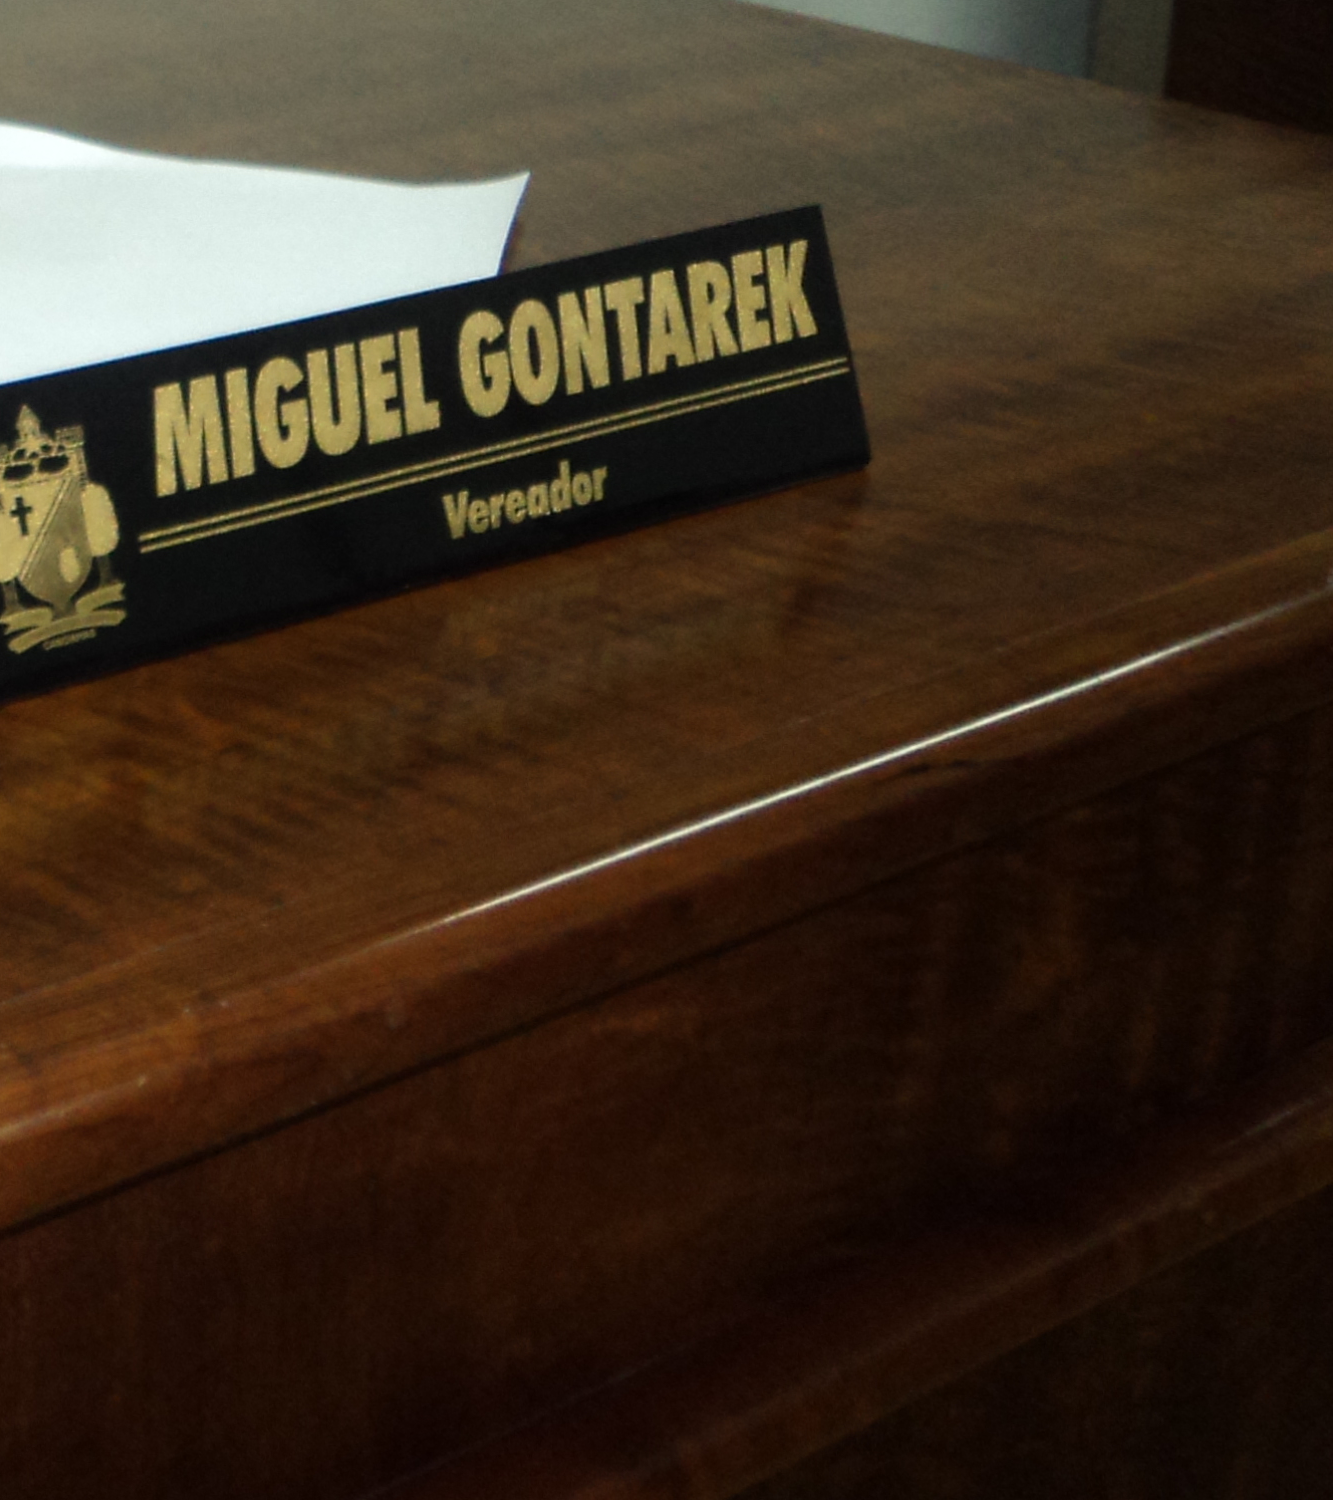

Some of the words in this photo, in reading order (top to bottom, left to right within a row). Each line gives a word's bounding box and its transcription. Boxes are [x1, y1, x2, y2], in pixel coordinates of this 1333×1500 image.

[153, 327, 441, 497] MIGUEL
[458, 240, 818, 417] GONTAREK
[443, 462, 607, 538] Vereador
